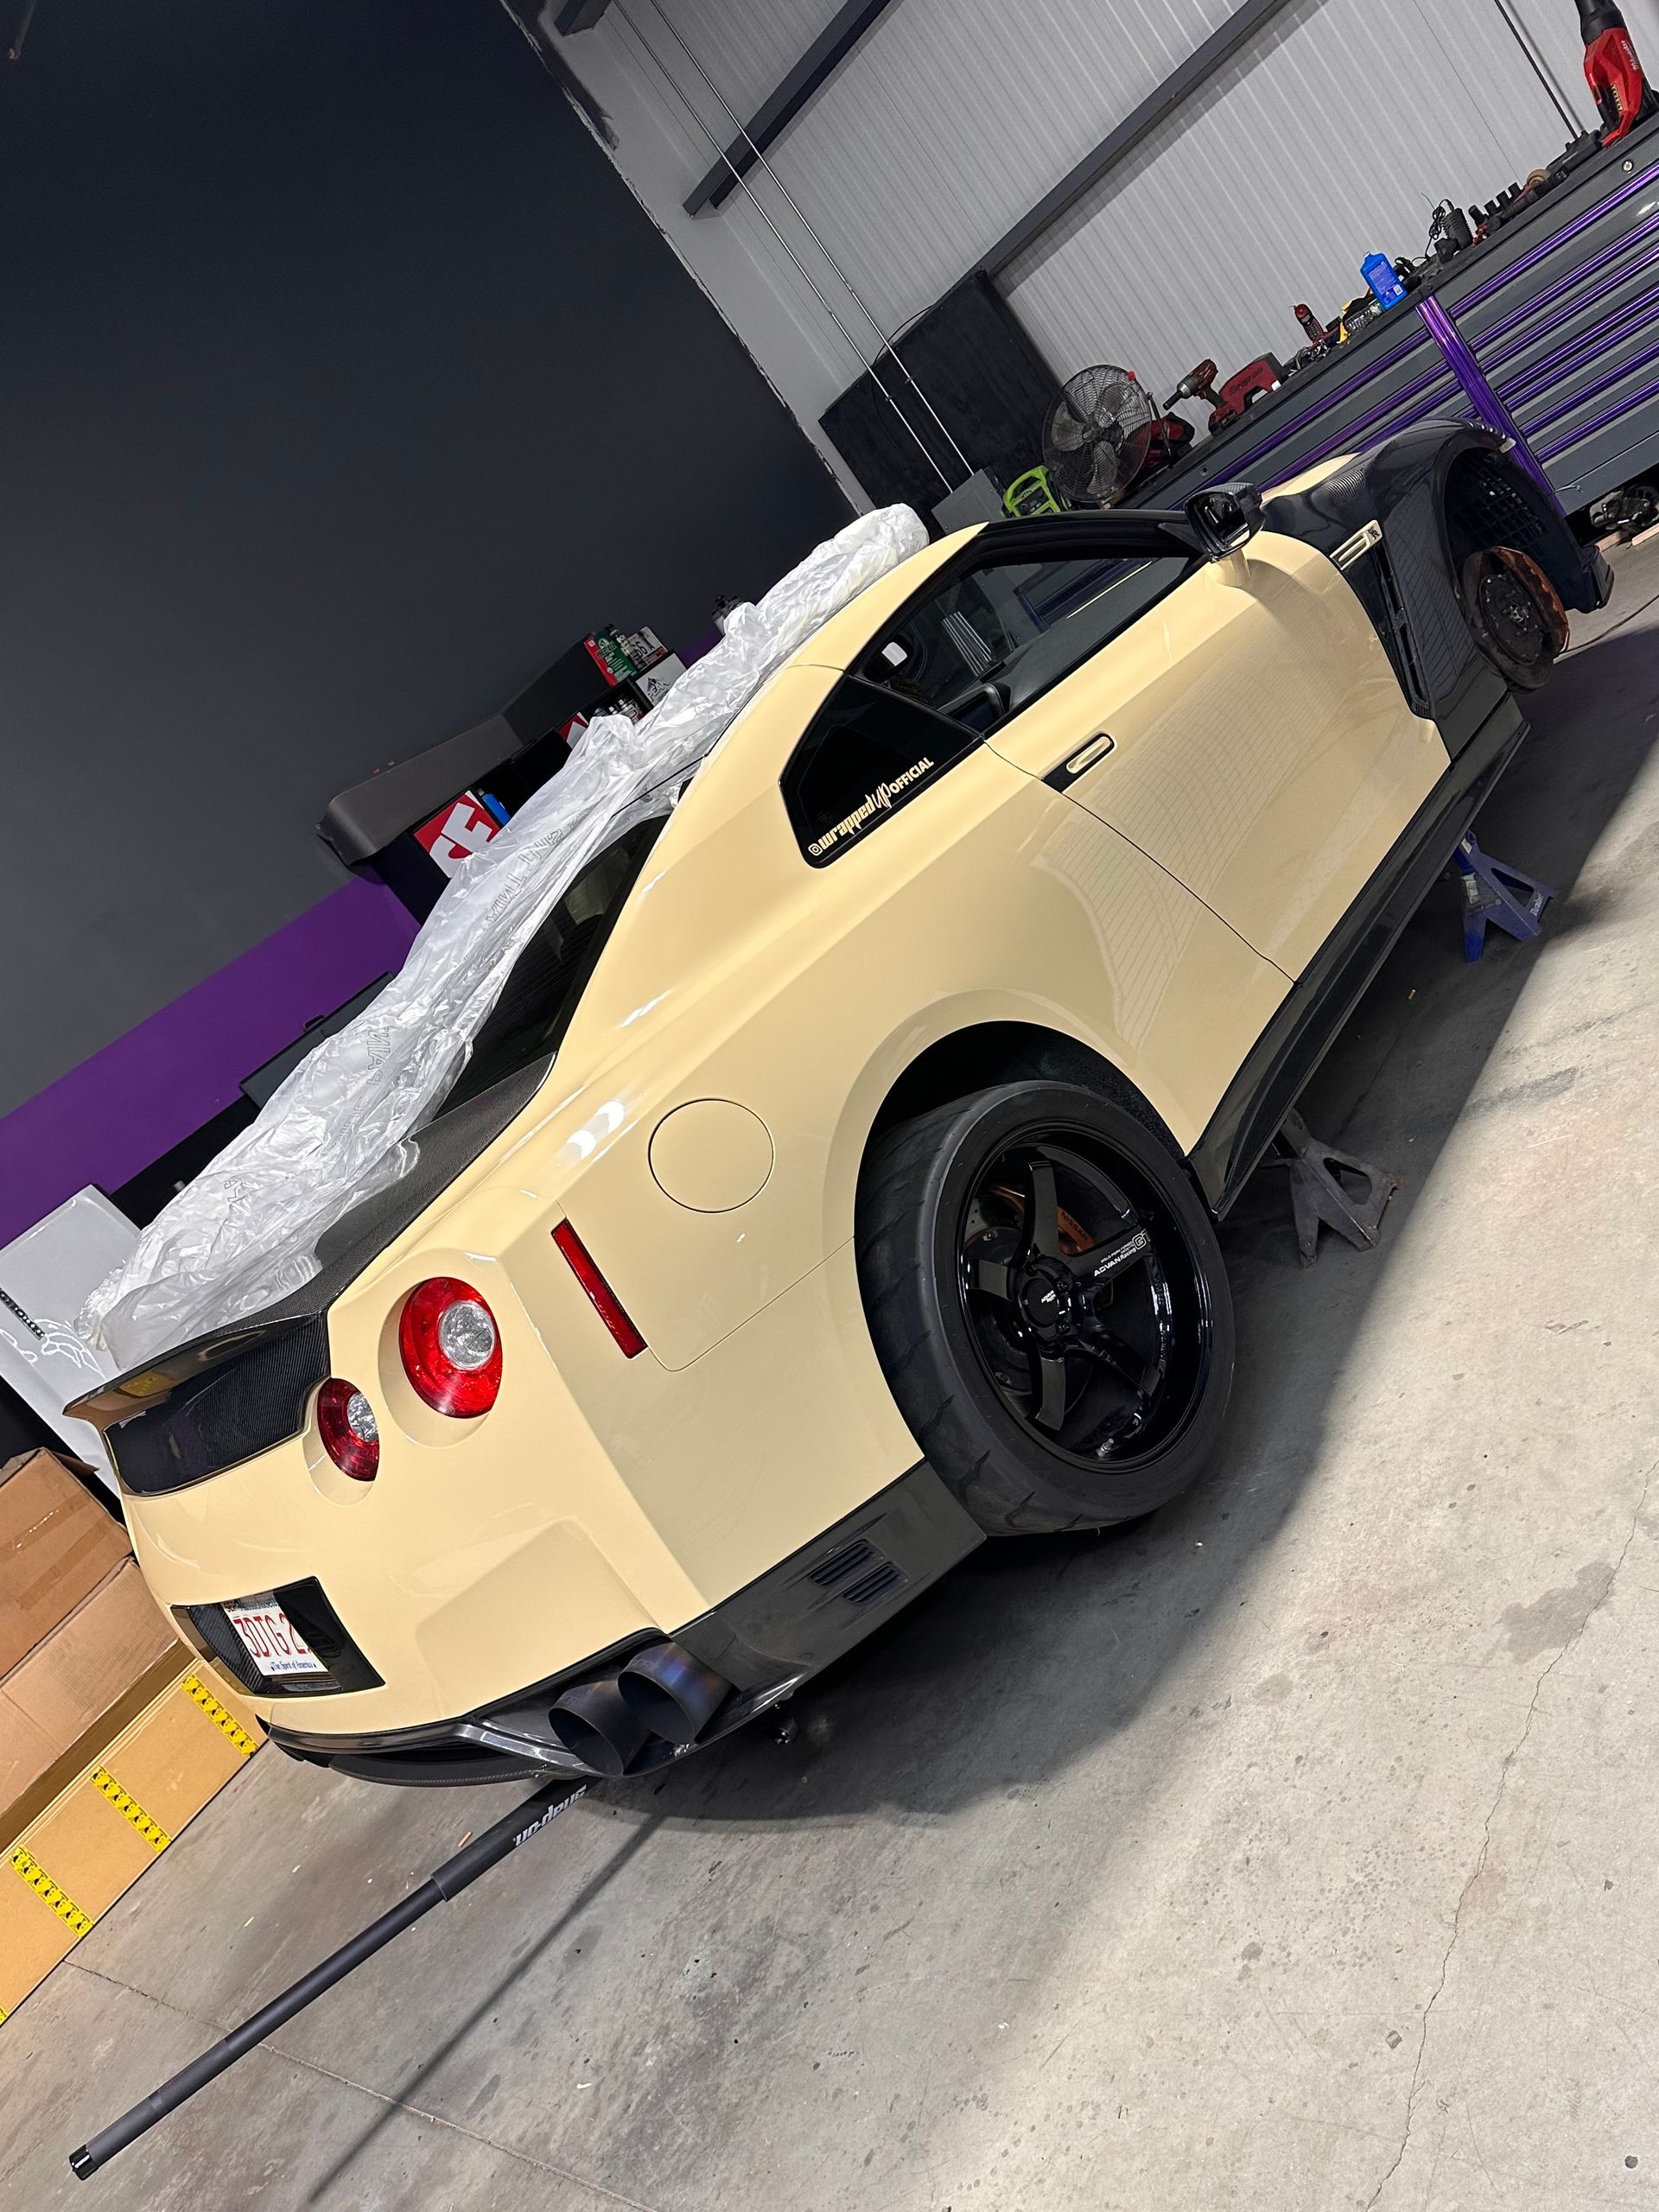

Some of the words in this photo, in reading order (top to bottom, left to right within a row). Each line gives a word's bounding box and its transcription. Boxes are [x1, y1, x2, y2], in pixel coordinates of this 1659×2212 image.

[1060, 1211, 1089, 1242] NISSAN
[1094, 1256, 1122, 1277] ADVAN
[1120, 1247, 1137, 1261] Racing
